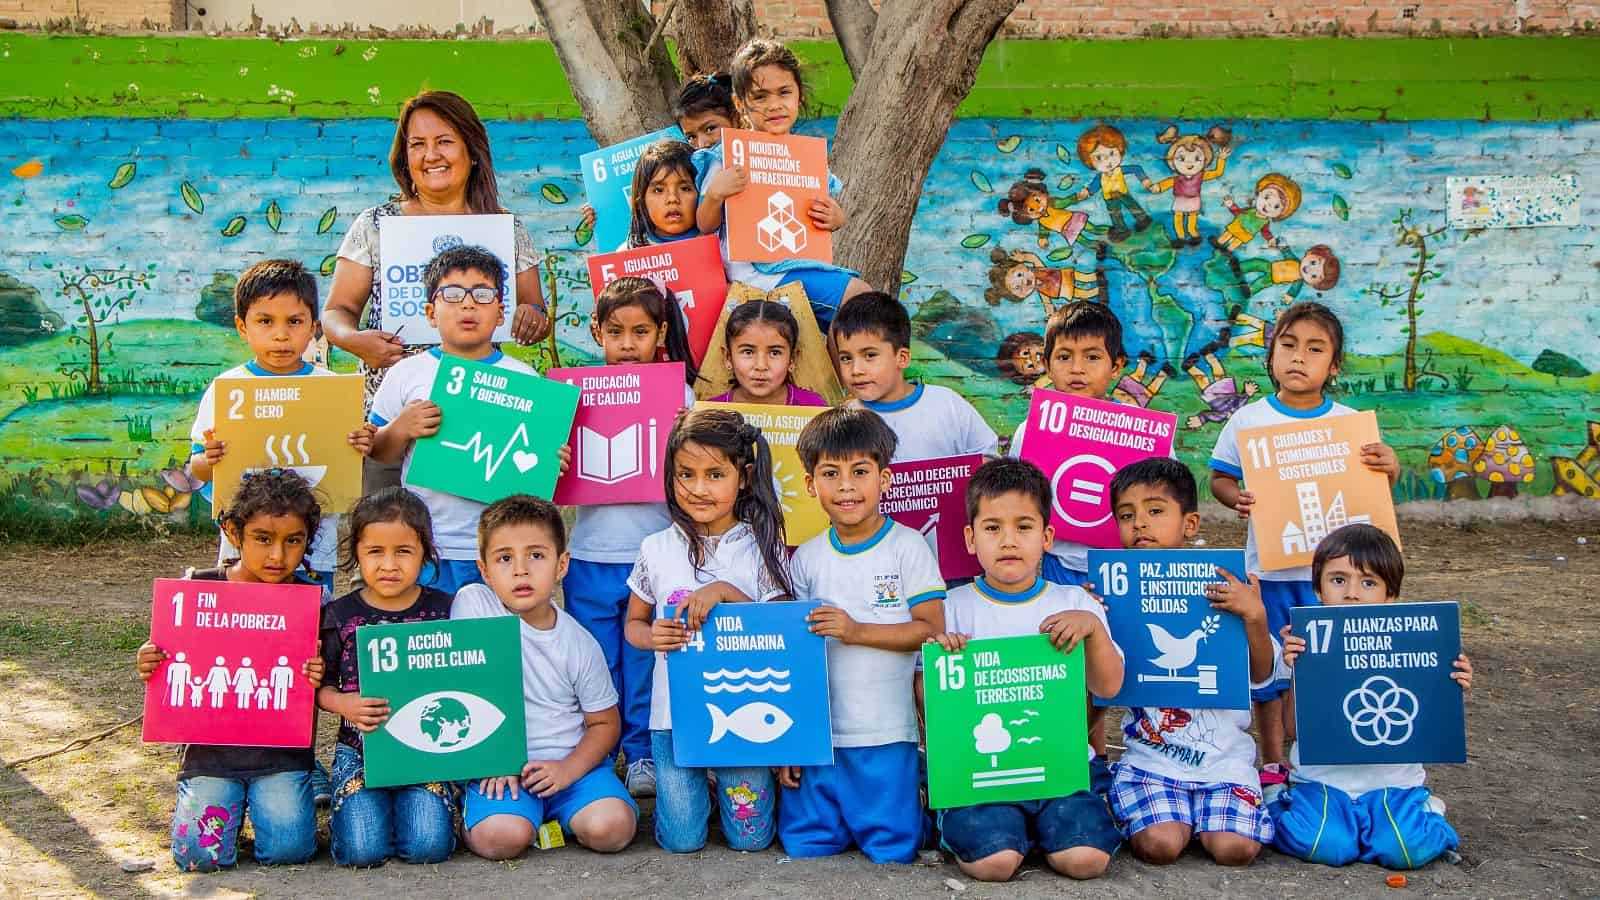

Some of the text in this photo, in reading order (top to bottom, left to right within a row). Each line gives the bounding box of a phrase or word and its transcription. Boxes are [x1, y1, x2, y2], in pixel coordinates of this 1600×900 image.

[612, 146, 635, 165] AGUA
[732, 139, 744, 166] 9
[749, 141, 791, 157] INDUSTRIA,
[593, 158, 608, 183] 6
[614, 165, 620, 176] Y
[750, 156, 795, 172] INNOVACIÓN
[750, 171, 820, 188] INFRAESTRUCTURA
[624, 253, 672, 273] IGUALDAD
[389, 287, 409, 299] DE
[446, 366, 466, 395] 3
[473, 371, 508, 390] SALUD
[582, 373, 640, 390] EDUCACIÓN
[229, 388, 245, 420] 2
[255, 388, 301, 402] HAMBRE
[470, 386, 533, 413] Y BIENESTAR
[583, 391, 641, 406] DE CALIDAD
[255, 405, 284, 418] CERO
[1039, 400, 1066, 433] 10
[1072, 406, 1170, 437] REDUCCIÓN DE LAS
[1069, 423, 1155, 452] DESIGUALDADES
[1273, 428, 1333, 448] CIUDADES Y
[1248, 437, 1271, 469] 11
[1276, 442, 1350, 465] COMUNIDADES
[926, 465, 971, 481] DECENTE
[1279, 459, 1346, 481] SOSTENIBLES
[886, 481, 953, 499] CRECIMIENTO
[879, 496, 938, 514] ECONÓMICO
[1099, 562, 1128, 596] 16
[1140, 562, 1216, 579] PAZ, JUSTICIA
[1140, 581, 1147, 595] E
[172, 592, 184, 627] 1
[198, 592, 217, 608] FIN
[1141, 596, 1188, 613] SÓLIDAS
[196, 611, 286, 631] DE LA POBREZA
[714, 616, 743, 632] VIDA
[1343, 616, 1439, 634] ALIANZAS PARA
[408, 632, 452, 650] ACCIÓN
[716, 634, 785, 652] SUBMARINA
[1306, 619, 1333, 654] 17
[1344, 635, 1392, 652] LOGRAR
[368, 637, 399, 672] 13
[409, 650, 486, 670] POR EL CLIMA
[973, 651, 1000, 668] VIDA
[1345, 652, 1438, 670] LOS OBJETIVOS
[935, 654, 965, 691] 15
[974, 664, 1067, 687] DE ECOSISTEMAS
[975, 685, 1044, 705] TERRESTRES
